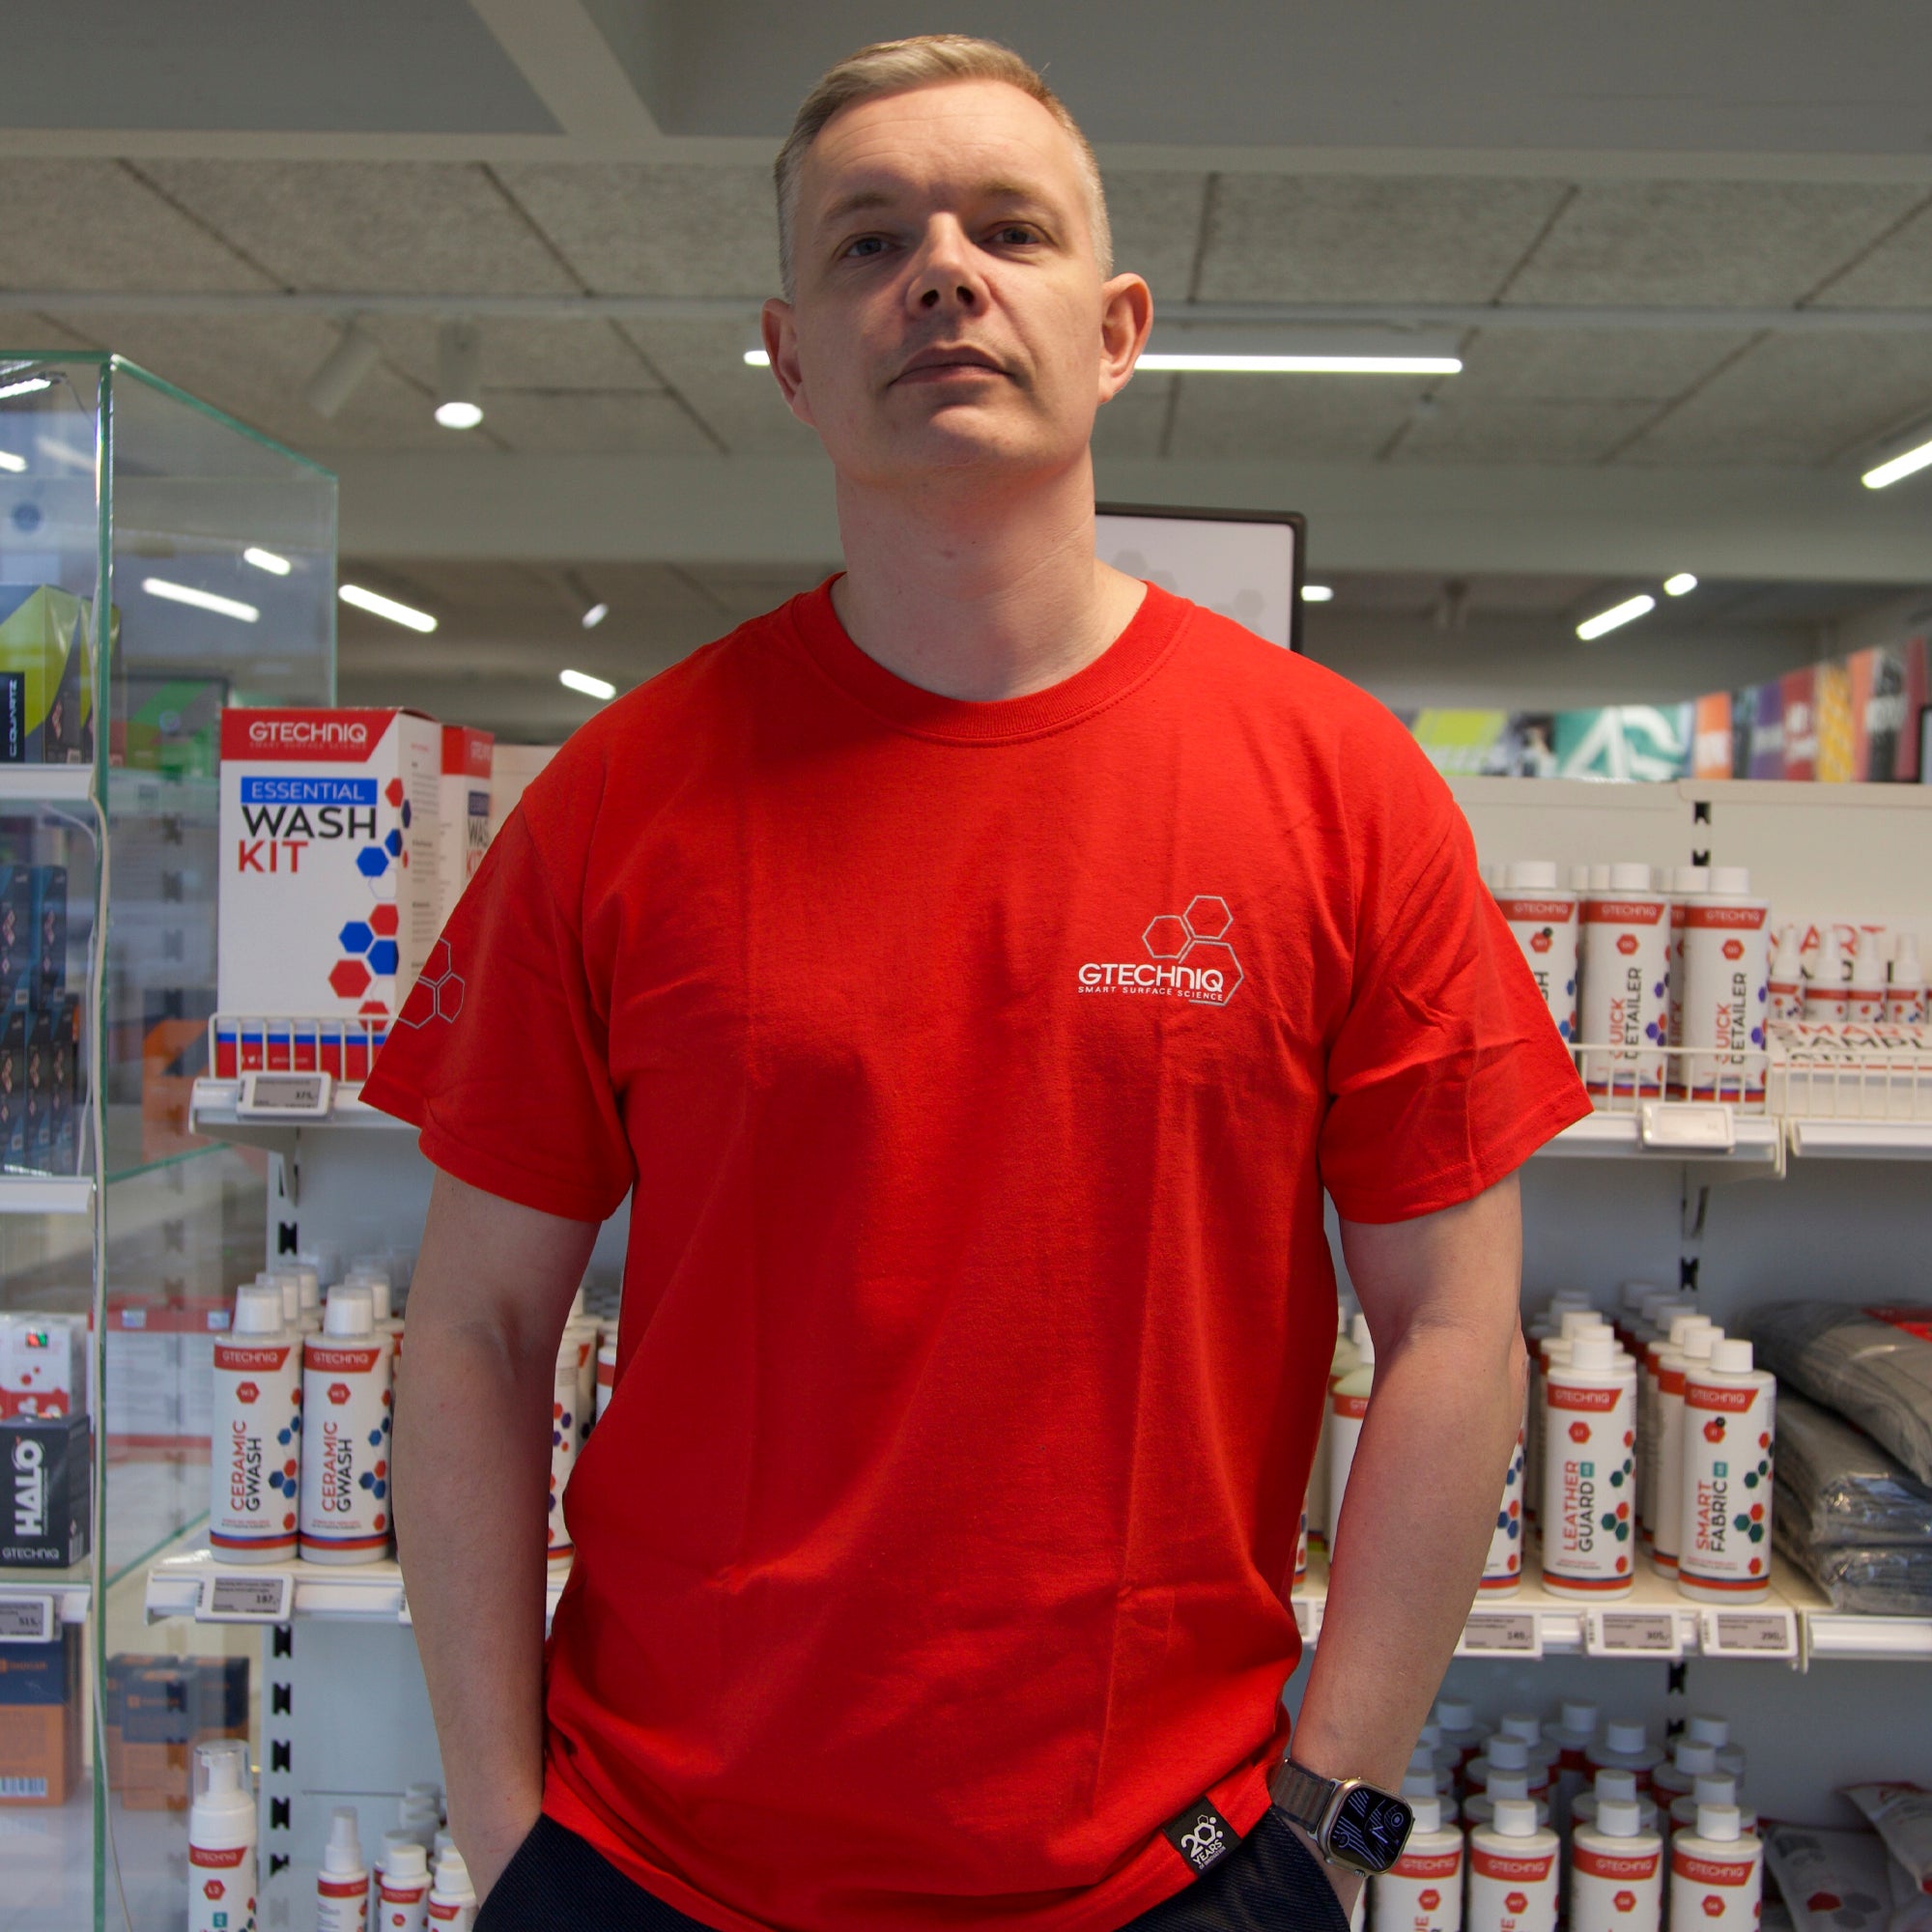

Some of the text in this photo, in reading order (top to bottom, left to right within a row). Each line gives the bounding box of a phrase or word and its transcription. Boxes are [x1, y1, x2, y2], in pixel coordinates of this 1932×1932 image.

[249, 722, 368, 743] GTECHNIQ
[242, 806, 377, 838] WASH
[251, 782, 365, 801] ESSENTIAL
[239, 840, 308, 872] KIT
[1078, 963, 1224, 992] GTECHNIQ
[1178, 990, 1223, 1001] SCIENCE
[1625, 967, 1642, 1061] DETAILER
[1730, 972, 1747, 1065] DETAILER
[14, 1439, 43, 1536] HALO
[231, 1420, 246, 1511] CERAMIC
[245, 1437, 262, 1512] GWASH
[322, 1421, 338, 1512] CERAMIC
[336, 1438, 352, 1513] GWASH
[1563, 1461, 1578, 1551] LEATHER
[1578, 1481, 1594, 1552] GUARD
[1695, 1480, 1712, 1550] SMART
[1711, 1481, 1727, 1552] FABRIC
[1193, 1839, 1223, 1864] YEARS
